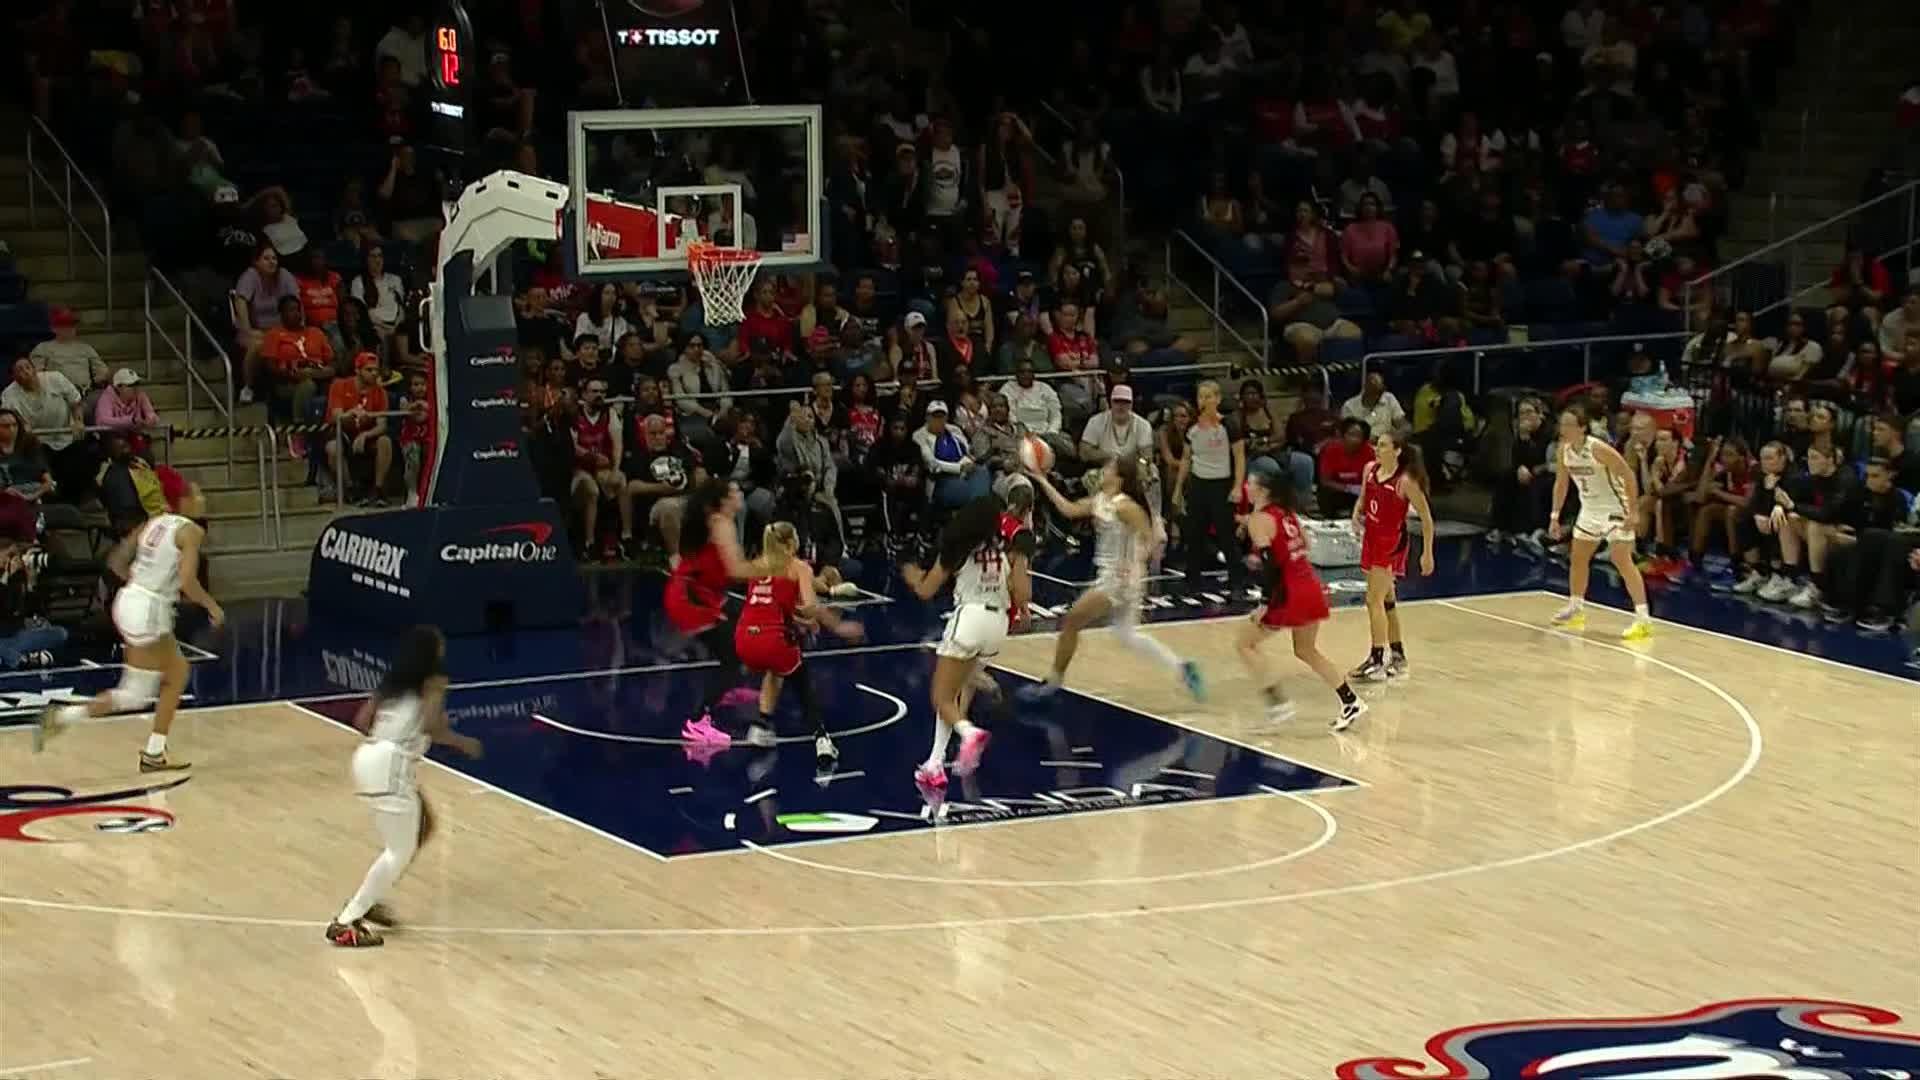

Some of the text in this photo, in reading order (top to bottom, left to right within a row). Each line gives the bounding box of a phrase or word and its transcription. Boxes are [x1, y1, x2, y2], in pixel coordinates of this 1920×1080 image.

[645, 29, 719, 45] TISSOT
[443, 53, 459, 84] 12
[1369, 499, 1379, 514] 0
